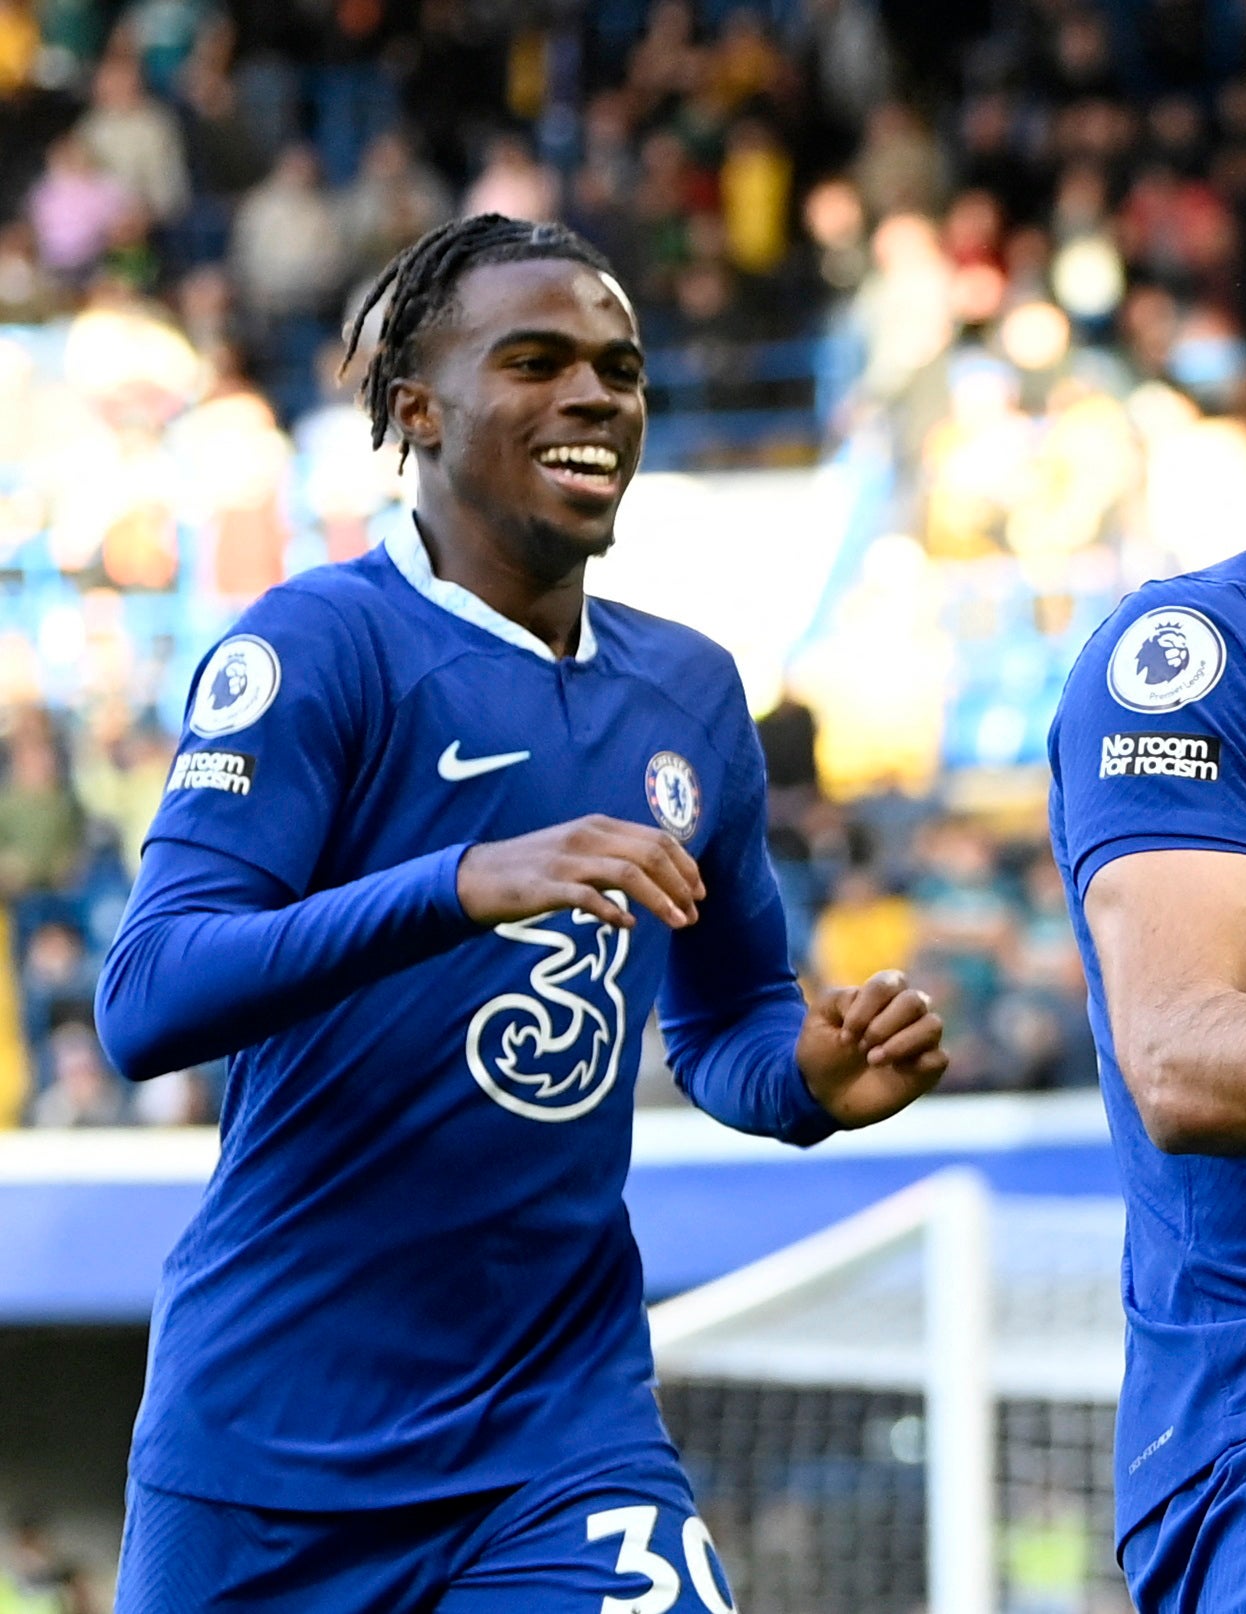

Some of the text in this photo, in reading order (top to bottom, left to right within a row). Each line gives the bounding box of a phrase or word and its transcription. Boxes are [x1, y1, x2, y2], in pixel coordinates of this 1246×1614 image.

[1149, 660, 1206, 699] Premier League
[1102, 734, 1208, 759] No room
[190, 752, 245, 775] room
[1099, 755, 1218, 780] for racism
[184, 770, 250, 796] racism
